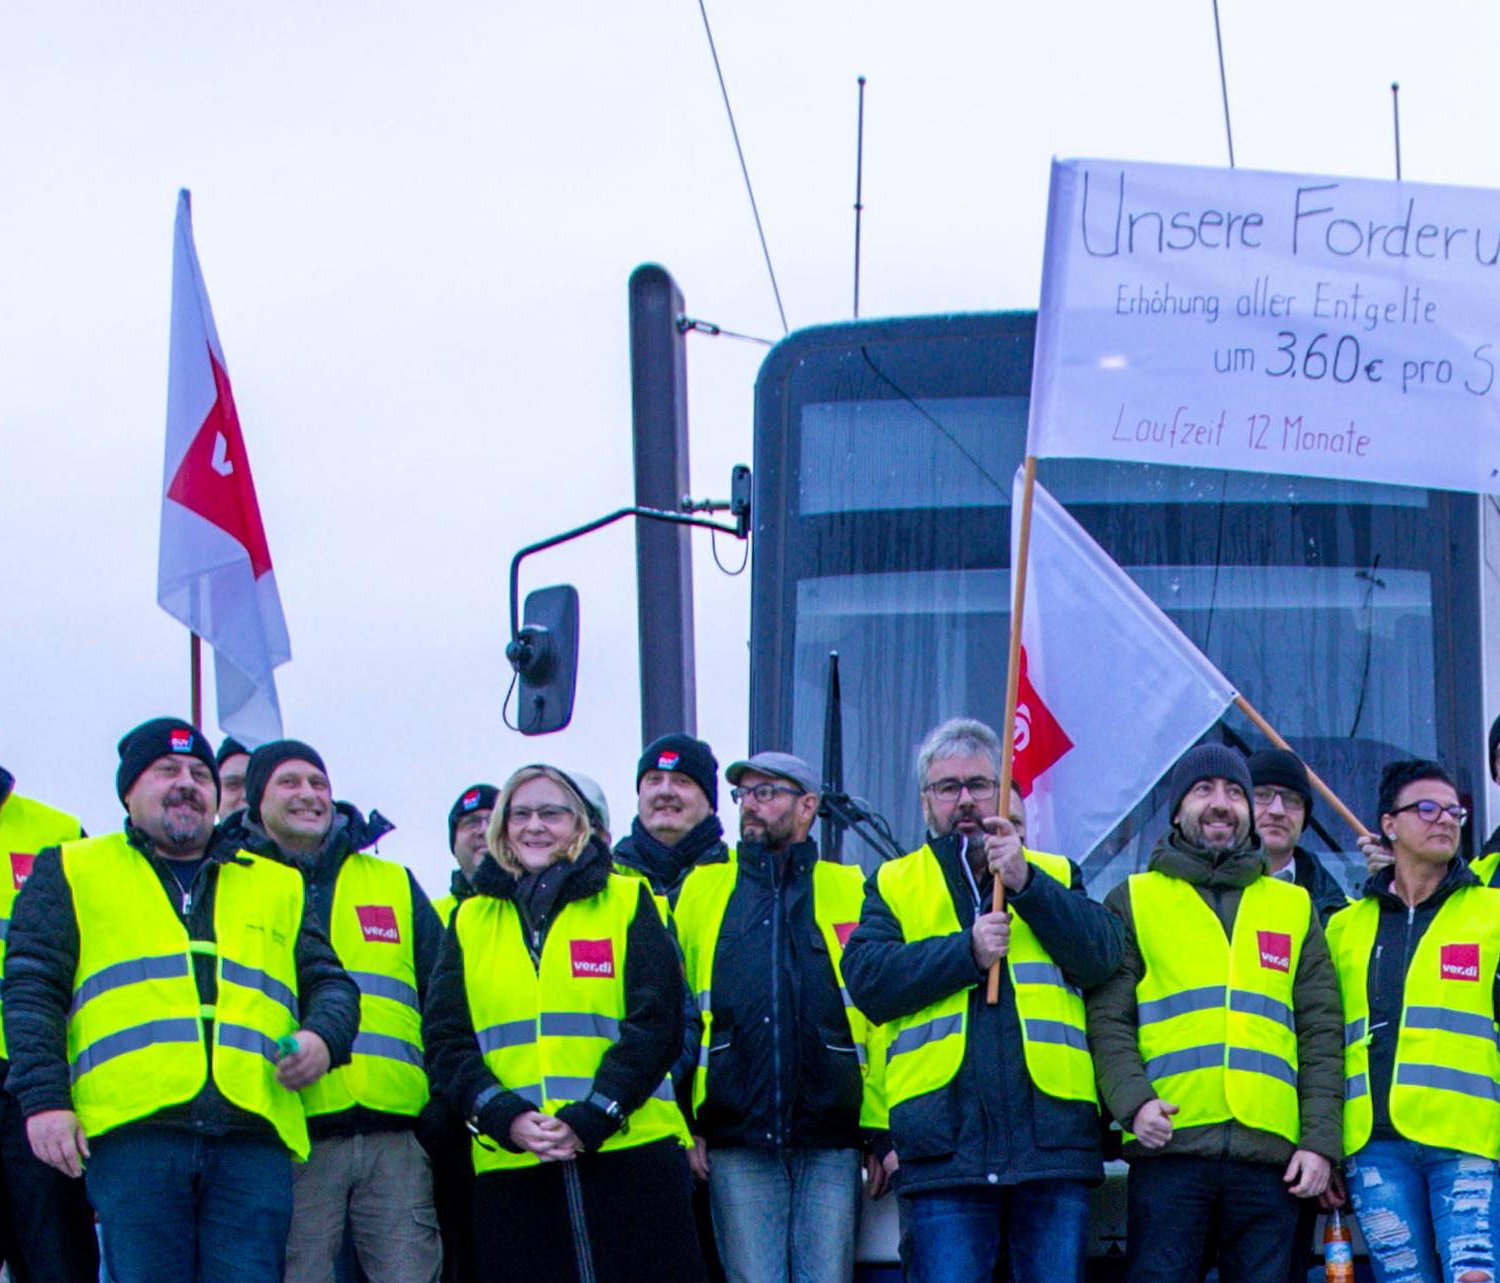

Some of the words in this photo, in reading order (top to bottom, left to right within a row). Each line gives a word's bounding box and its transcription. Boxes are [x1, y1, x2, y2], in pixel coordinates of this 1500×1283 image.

[1081, 170, 1264, 258] Unsere
[1236, 276, 1297, 318] aller
[1313, 282, 1437, 331] Entgelte
[1213, 347, 1255, 374] um
[1402, 358, 1453, 394] pro
[1111, 403, 1227, 449] Laufzeit
[1247, 414, 1271, 450] 12
[1281, 414, 1372, 457] Monate
[363, 925, 398, 940] ver.di
[573, 959, 612, 974] ver.di
[1260, 951, 1289, 969] ver.di
[1442, 962, 1478, 978] ver.di
